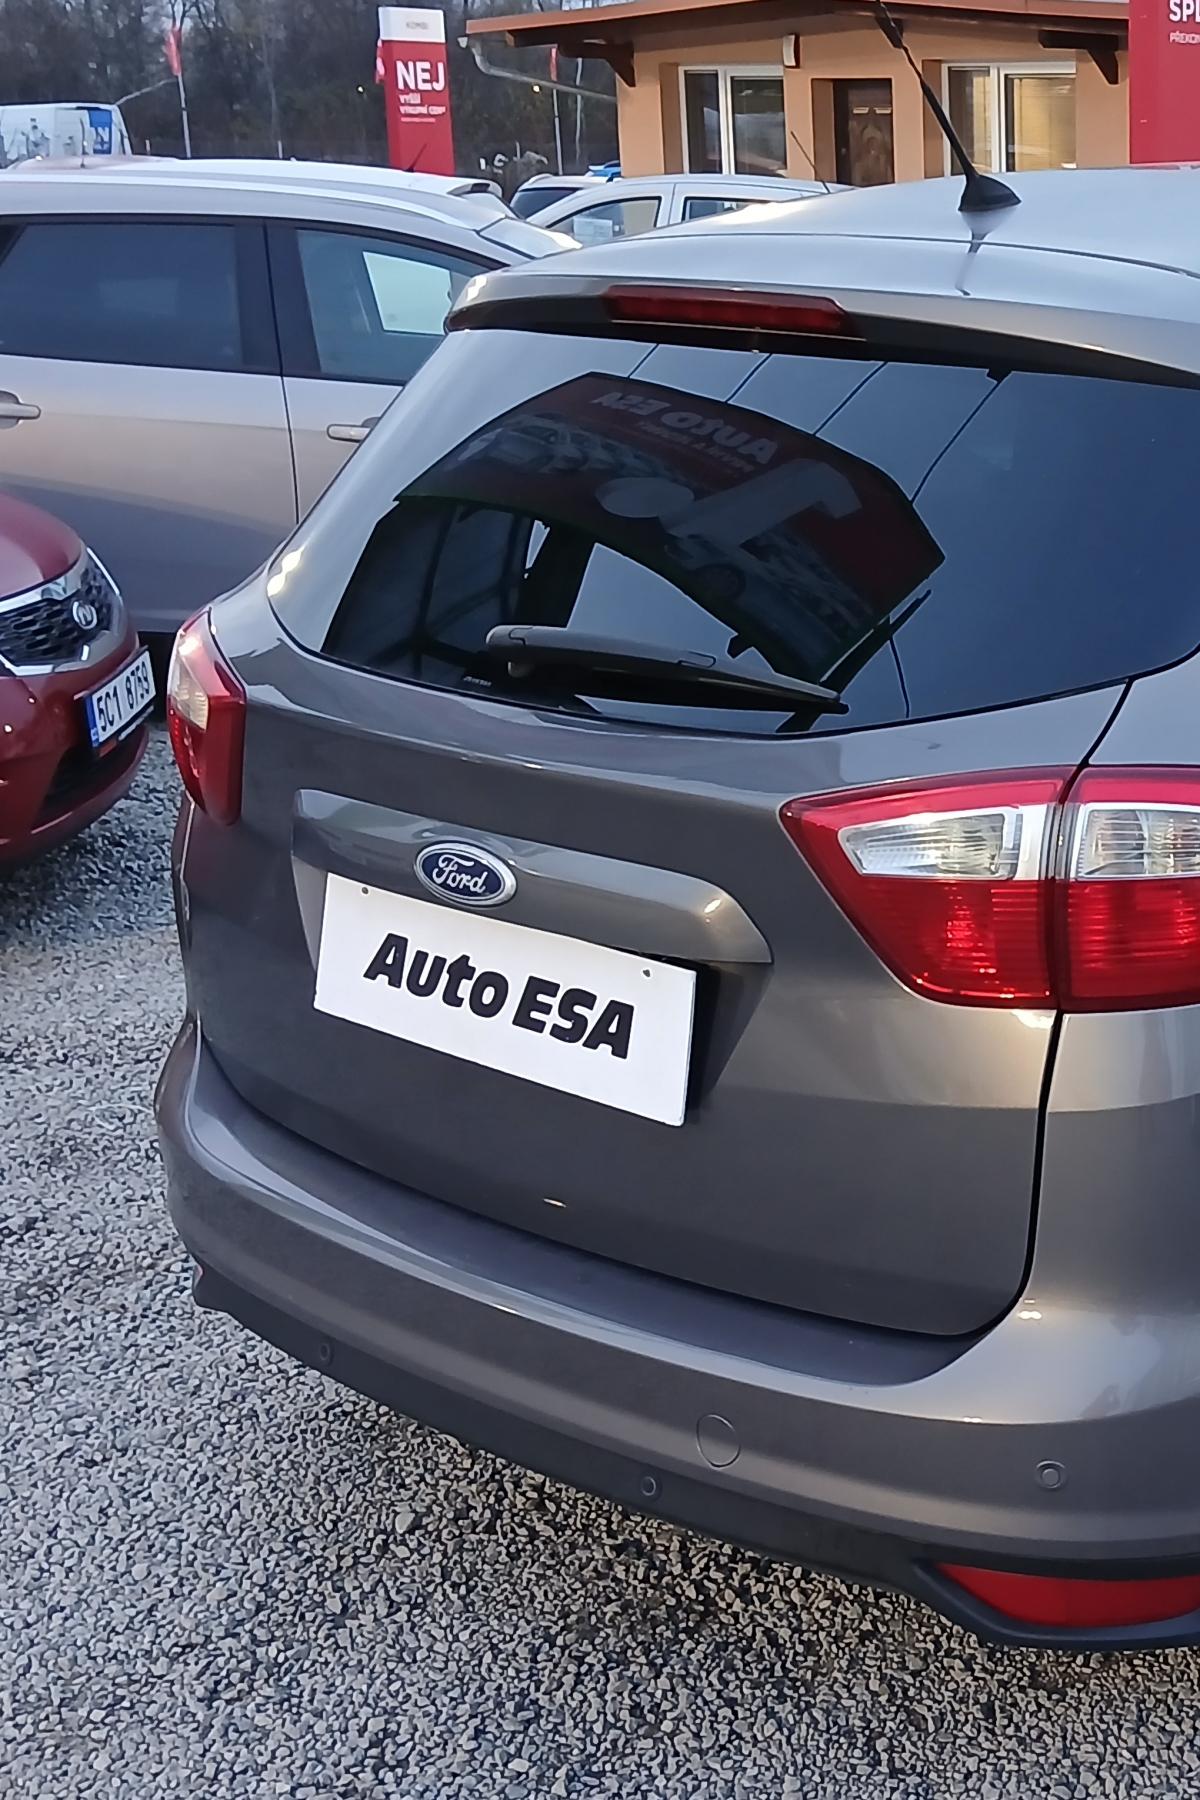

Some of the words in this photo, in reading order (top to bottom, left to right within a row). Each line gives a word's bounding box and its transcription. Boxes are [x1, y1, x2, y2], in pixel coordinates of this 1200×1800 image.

[395, 60, 446, 91] NEJ
[97, 685, 122, 732] 5C1
[125, 661, 150, 709] 8759
[432, 854, 486, 895] Ford
[363, 933, 509, 1018] Auto
[512, 975, 635, 1059] ESA
